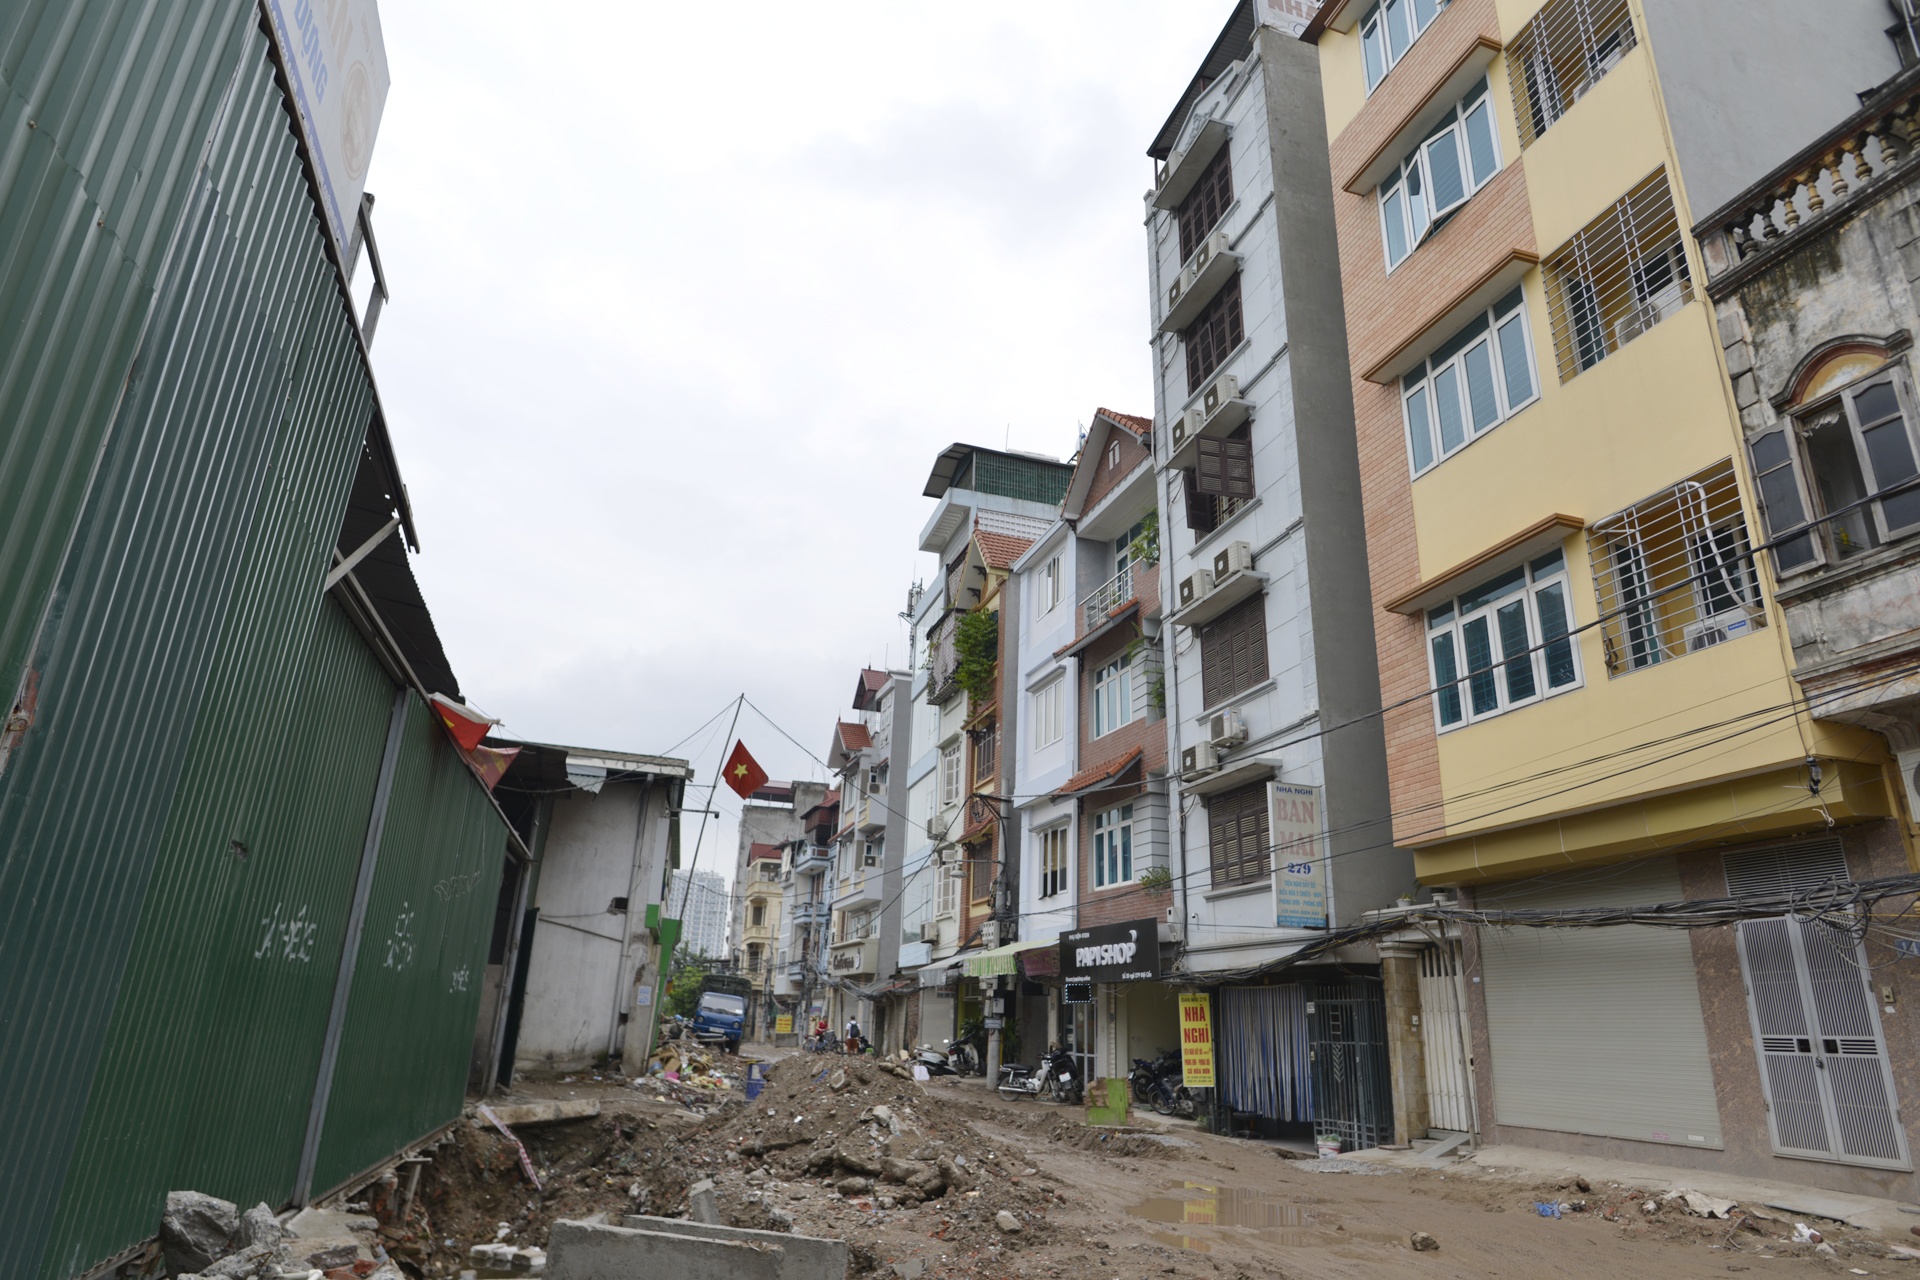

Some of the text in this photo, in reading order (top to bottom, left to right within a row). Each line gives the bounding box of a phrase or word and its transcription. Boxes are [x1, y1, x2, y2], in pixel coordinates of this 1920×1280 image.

[1276, 784, 1313, 796] NHÀ NGHỈ
[1276, 798, 1315, 825] BAN
[1280, 831, 1315, 857] MAI
[1287, 862, 1311, 875] 279
[1184, 1004, 1206, 1022] NHÀ
[1184, 1023, 1210, 1043] NGHỈ
